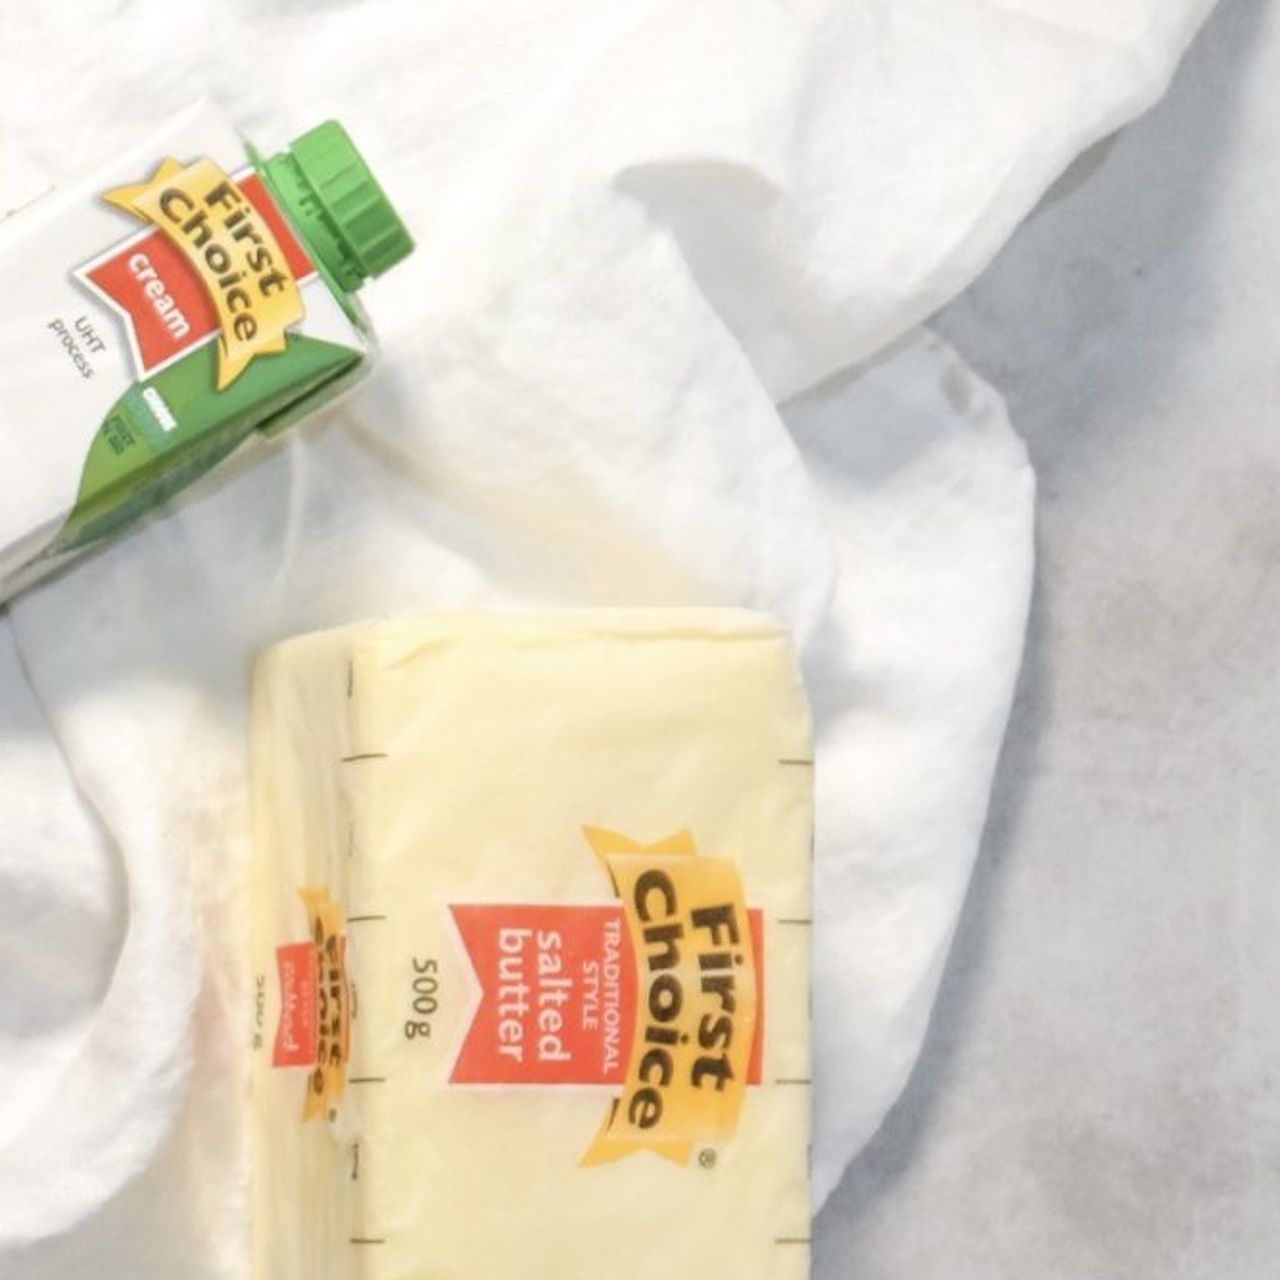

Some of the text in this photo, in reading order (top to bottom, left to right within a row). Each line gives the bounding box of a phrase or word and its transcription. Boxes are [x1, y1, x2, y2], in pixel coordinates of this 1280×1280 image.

[127, 253, 191, 340] cream
[158, 187, 258, 342] Choice
[205, 180, 289, 298] First
[47, 318, 95, 379] process
[74, 316, 107, 353] UHT
[405, 958, 438, 1041] 500 g
[498, 928, 532, 1062] butter
[537, 930, 572, 1061] salted
[583, 961, 598, 1030] STYLE
[603, 917, 621, 1074] TRADITIONAL
[628, 869, 689, 1129] Choice
[691, 903, 744, 1092] First
